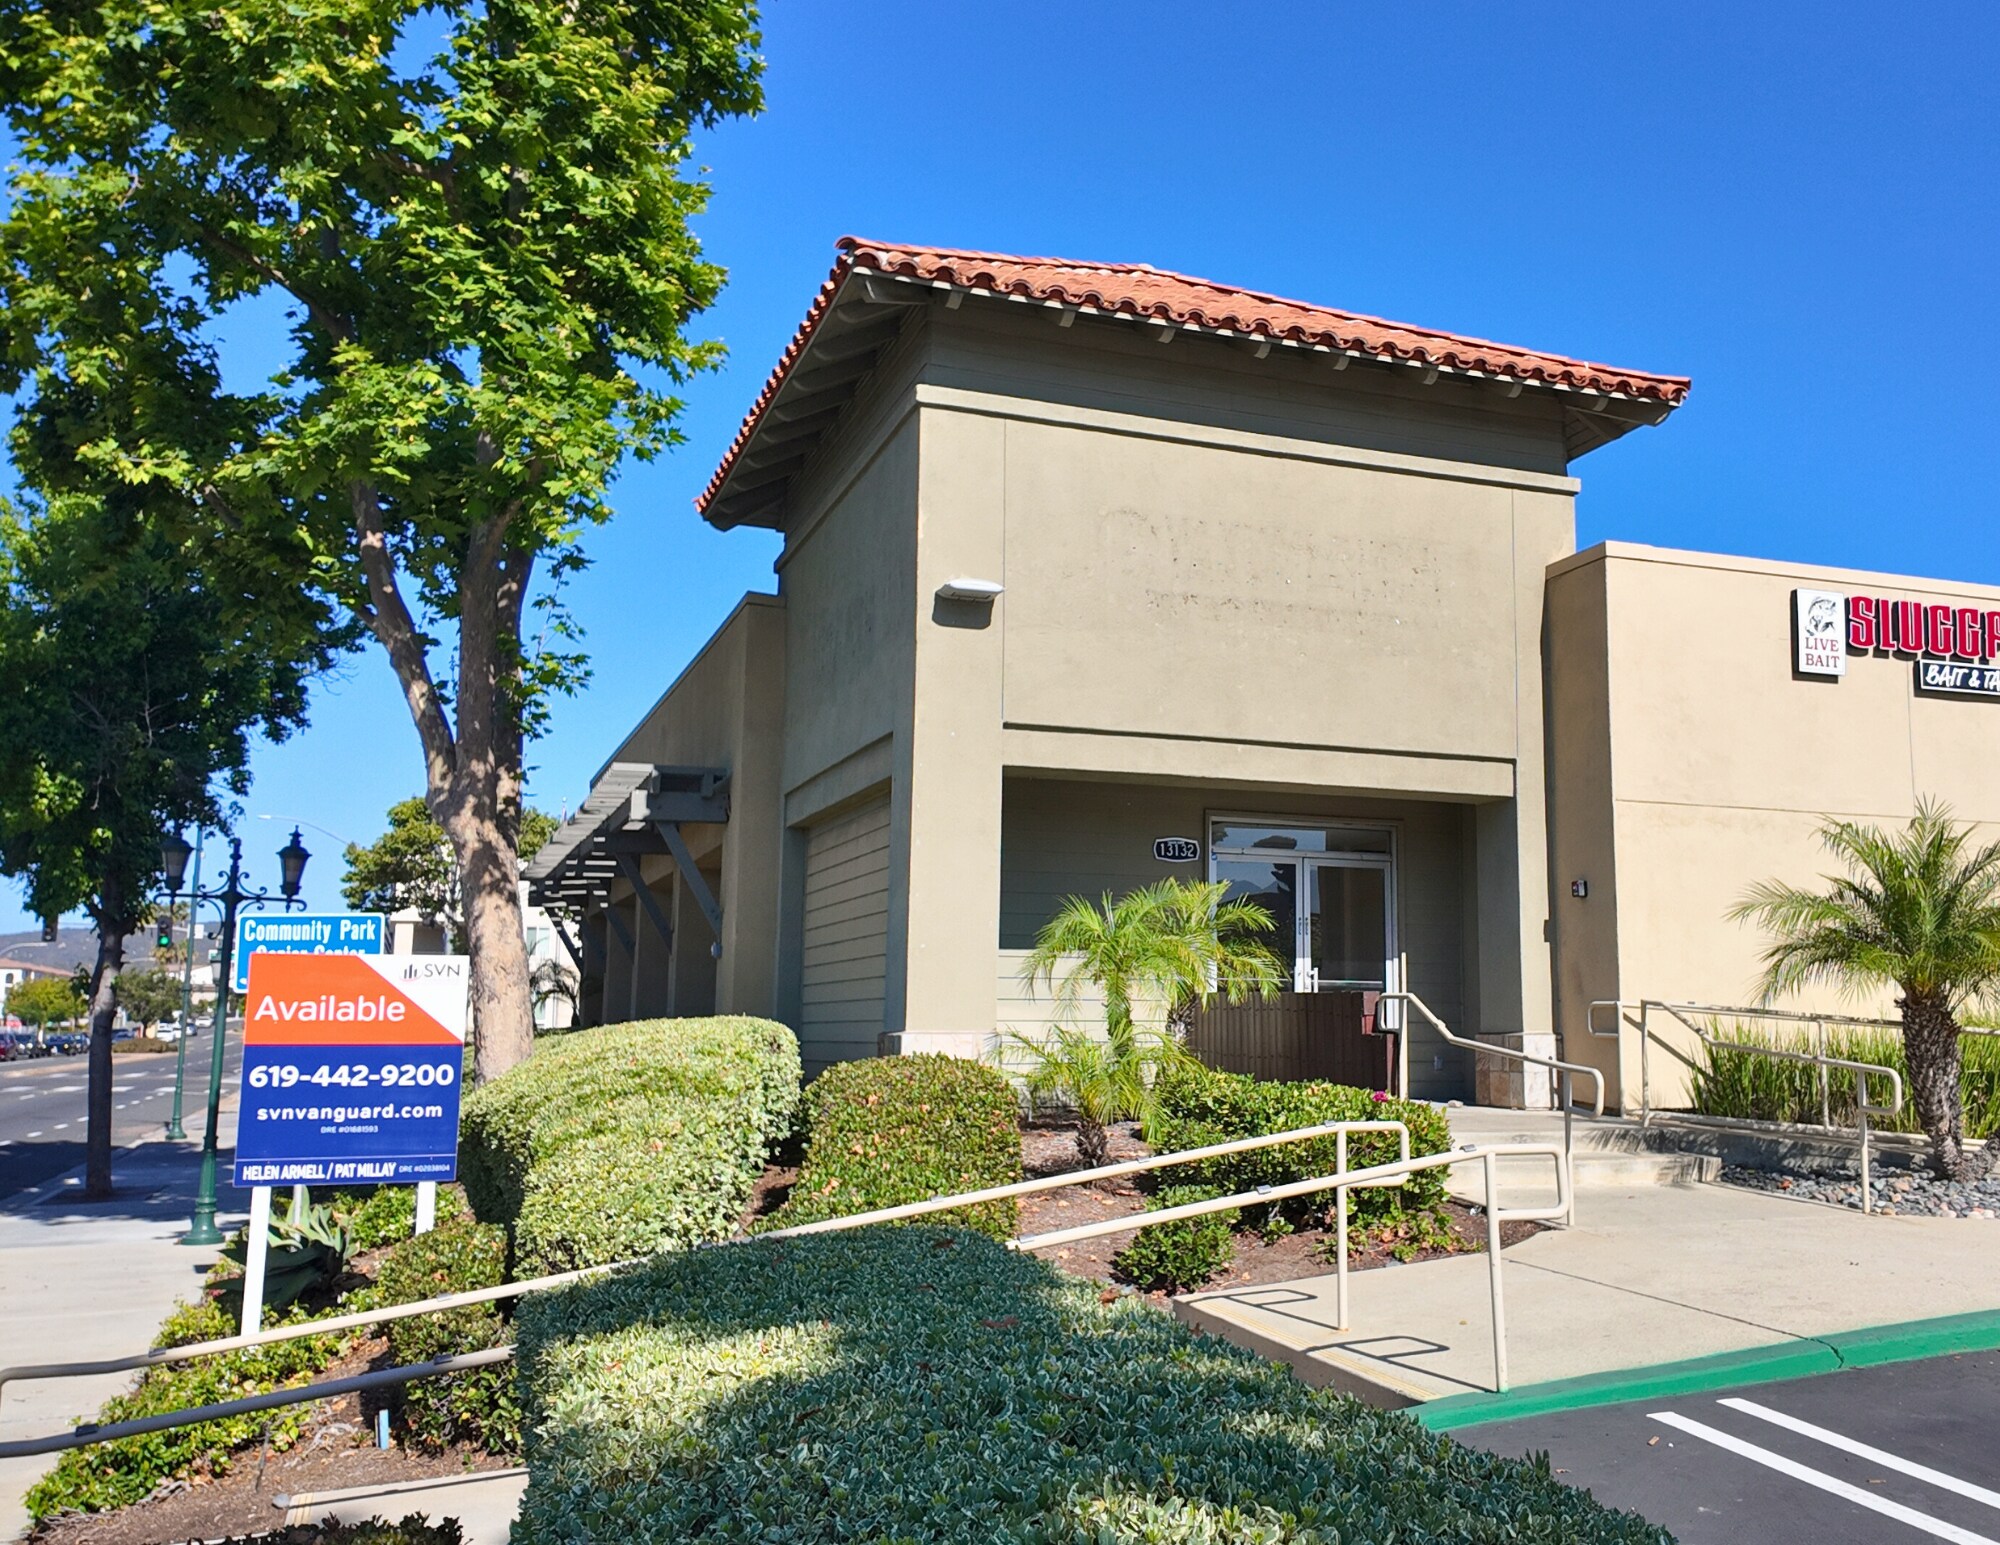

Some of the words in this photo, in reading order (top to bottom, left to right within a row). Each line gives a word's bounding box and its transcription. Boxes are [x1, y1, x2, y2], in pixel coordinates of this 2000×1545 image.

[1805, 637, 1839, 652] LIVE
[1805, 653, 1840, 668] BAIT
[1925, 664, 1969, 687] BAIT
[1968, 669, 1981, 688] &
[1160, 843, 1195, 857] 13132
[244, 919, 332, 944] Community
[340, 919, 376, 941] Park
[424, 963, 460, 978] SVN
[254, 995, 406, 1022] Available
[249, 1064, 454, 1088] 619-442-9200
[257, 1103, 442, 1122] svnvanguard.com
[242, 1165, 280, 1181] HELEN
[281, 1164, 326, 1180] ARMELL
[334, 1163, 357, 1179] PAT
[357, 1162, 397, 1178] MILLAY
